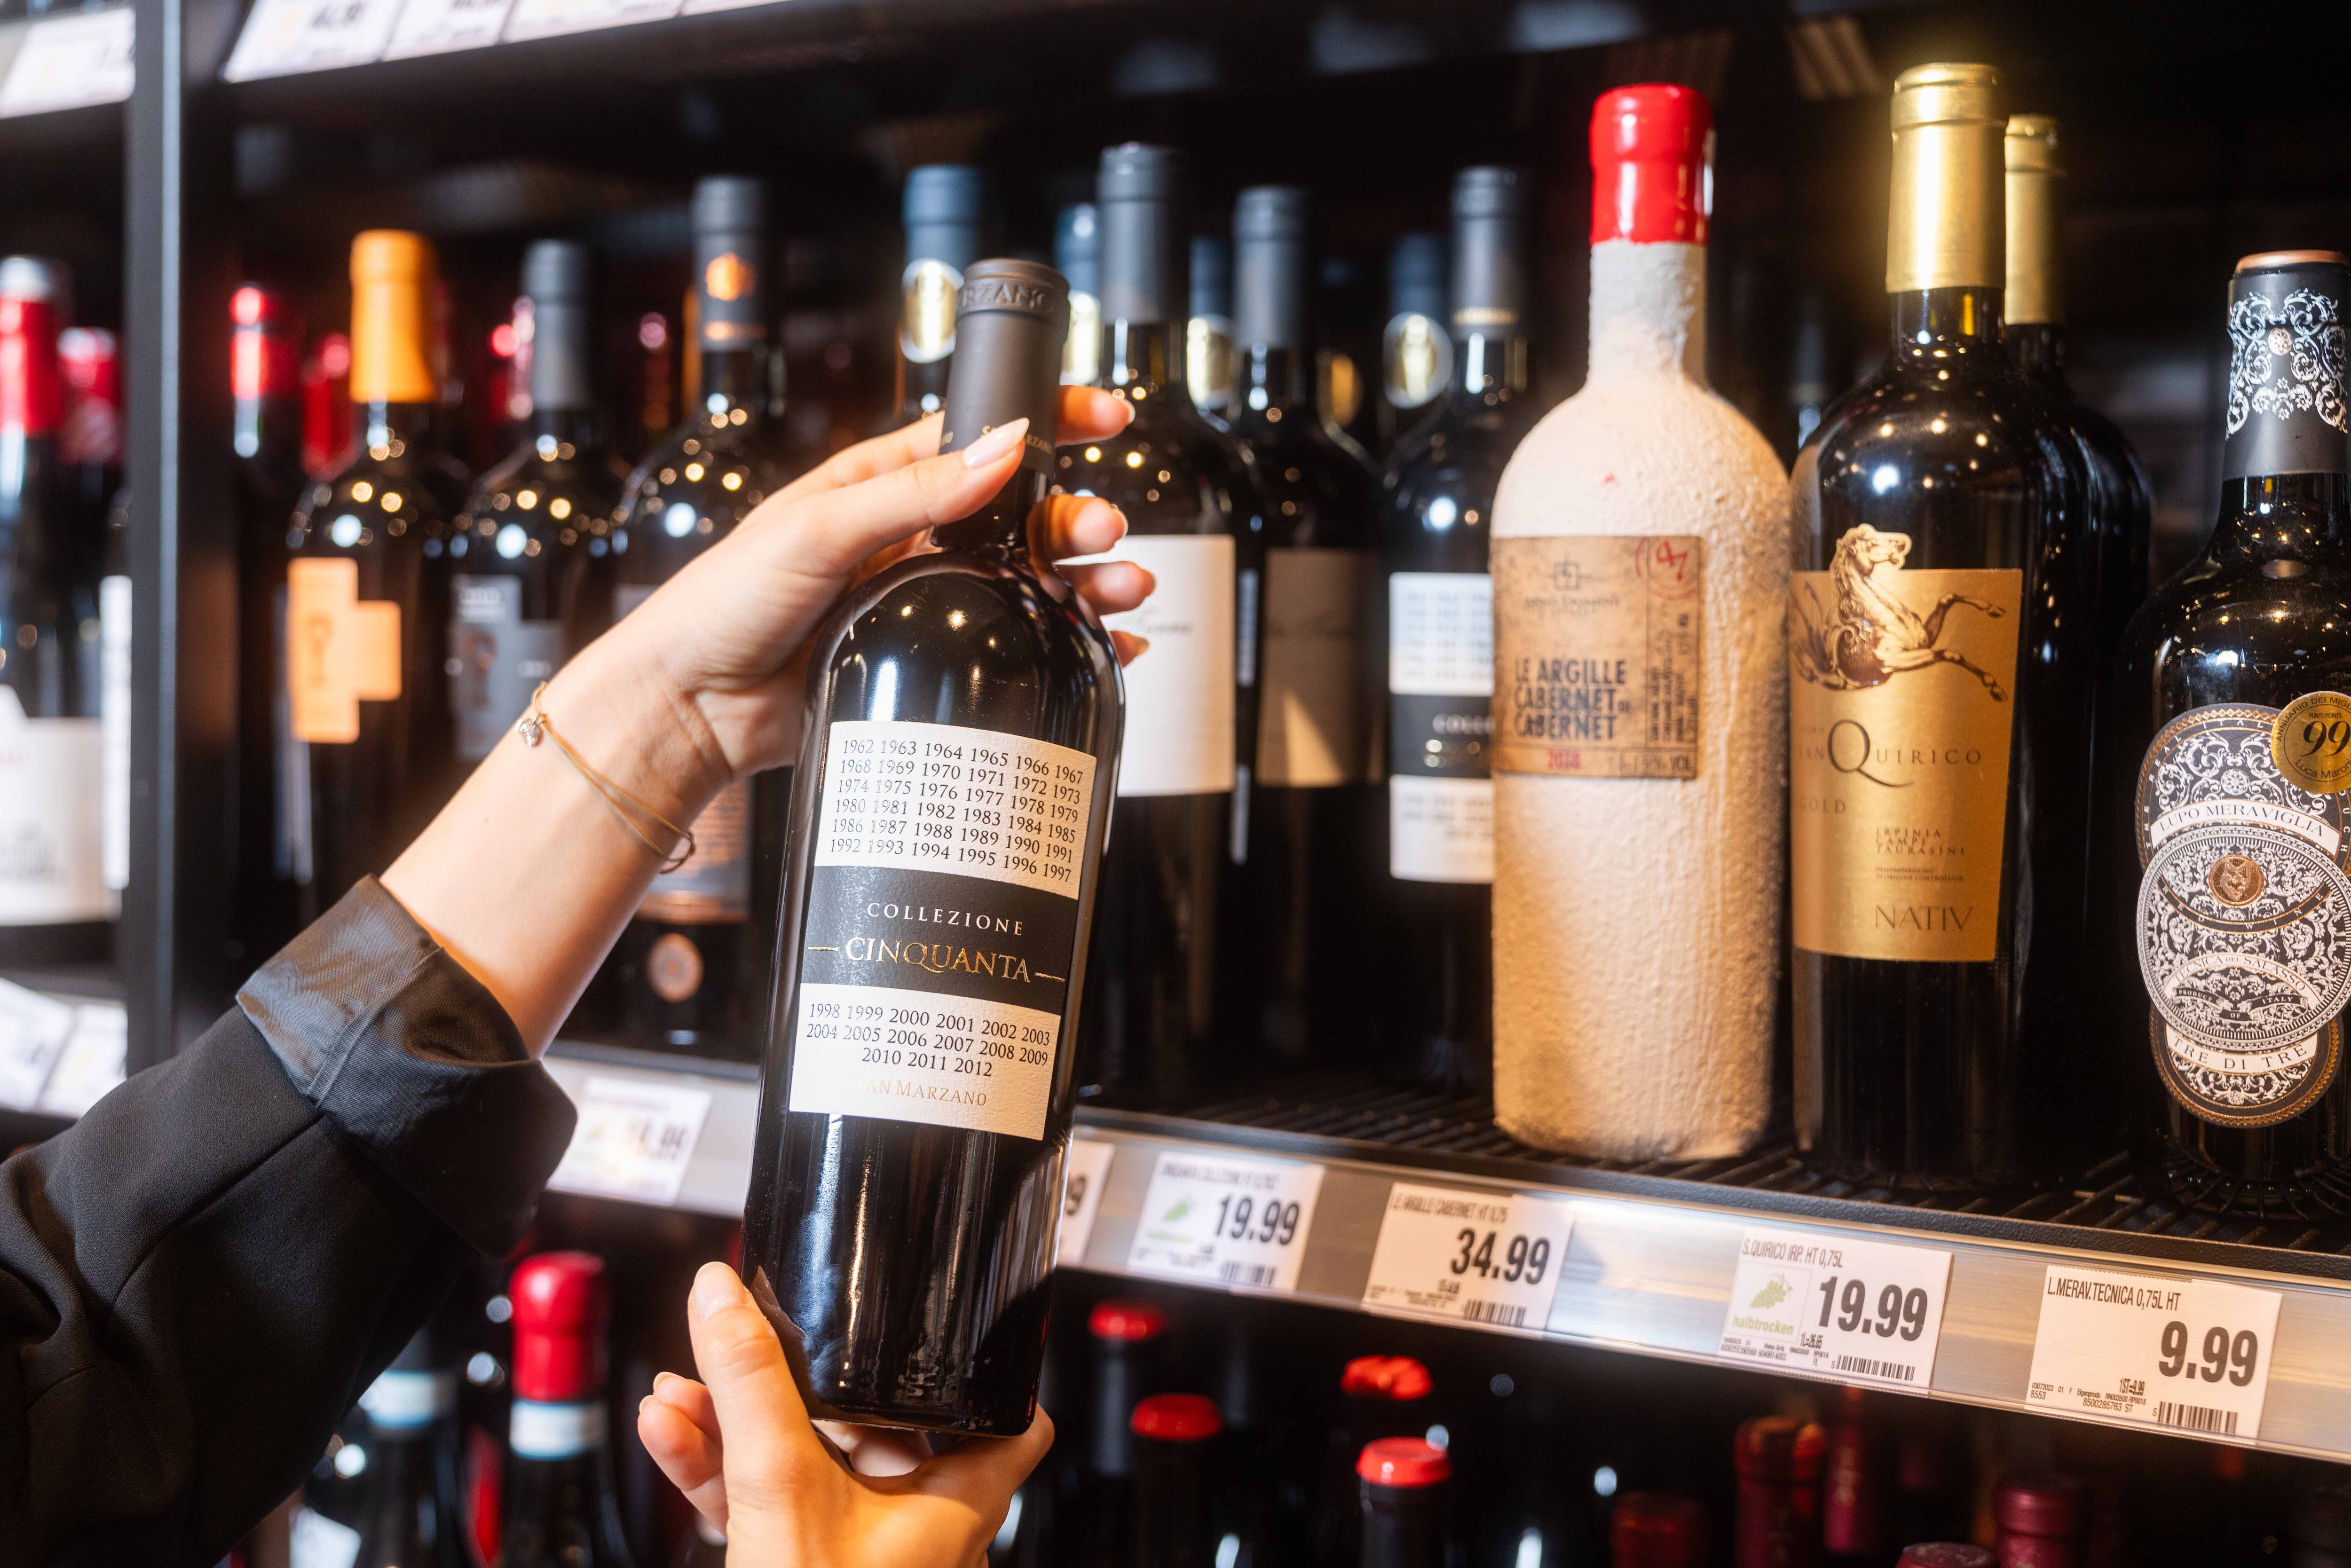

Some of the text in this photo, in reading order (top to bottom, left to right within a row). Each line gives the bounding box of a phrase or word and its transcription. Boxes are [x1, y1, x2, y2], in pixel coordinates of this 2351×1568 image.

[1515, 659, 1625, 684] LE ARGILLE
[1514, 686, 1617, 711] CABERNET
[1514, 713, 1617, 740] CABERNET
[2276, 701, 2308, 742] ANNUARIO
[2330, 697, 2351, 710] MIGL
[1827, 719, 1981, 788] QUIRICO
[2299, 721, 2351, 756] 99
[843, 739, 1083, 785] 1962 1963 1964 1965 1966 1967
[2295, 759, 2318, 778] Luca
[840, 759, 1081, 804] 1968 1969 1970 1971 1972 1973
[2203, 719, 2264, 729] ITAL
[2339, 789, 2351, 852] OUCH
[838, 779, 1078, 823] 1974 1975 1976 1977 1978 1979
[835, 799, 1076, 843] 1980 1981 1982 1983 1984 1985
[1876, 827, 1940, 838] IRPINIA
[2159, 804, 2323, 837] LUPO MERAVIGLIA
[833, 819, 1072, 863] 1986 1987 1988 1989 1990 1991
[1876, 837, 1925, 846] CAMPI
[1877, 846, 1965, 855] TAURASINI
[830, 838, 1071, 882] 1992 1993 1994 1995 1996 1997
[867, 903, 1023, 936] COLLEZIONE
[1875, 905, 1973, 931] NATIV
[2245, 893, 2323, 930] WINE
[845, 937, 1031, 983] CINQUANTA
[2176, 955, 2223, 982] TECNICA
[2244, 957, 2305, 990] SALASSO
[2178, 990, 2213, 1001] PRODUCT
[2262, 996, 2293, 1005] ITALY
[809, 1003, 1050, 1046] 1998 1999 2000 2001 2002 2003
[806, 1024, 1048, 1066] 2004 2005 2006 2007 2008 2009
[2173, 1038, 2307, 1070] TRE DI TRE
[862, 1048, 992, 1077] 2010 2011 2012
[856, 1077, 987, 1106] SAN MARZANO
[1215, 1193, 1300, 1245] 19.99
[1451, 1228, 1550, 1284] 34.99
[1742, 1238, 1843, 1268] S.QUIRICO IRP. HT 0,75L
[1819, 1276, 1928, 1341] 19.99
[2047, 1276, 2181, 1311] L.MERAV.TECNICA 0,75L HT
[1732, 1313, 1794, 1335] halbtrocken
[1831, 1360, 1836, 1369] S
[2158, 1321, 2258, 1387] 9.99
[2030, 1389, 2134, 1413] 8553 8500285763 ST
[2032, 1382, 2054, 1392] 03072023
[2077, 1388, 2101, 1399] Eigenprodu
[2152, 1407, 2157, 1417] S
